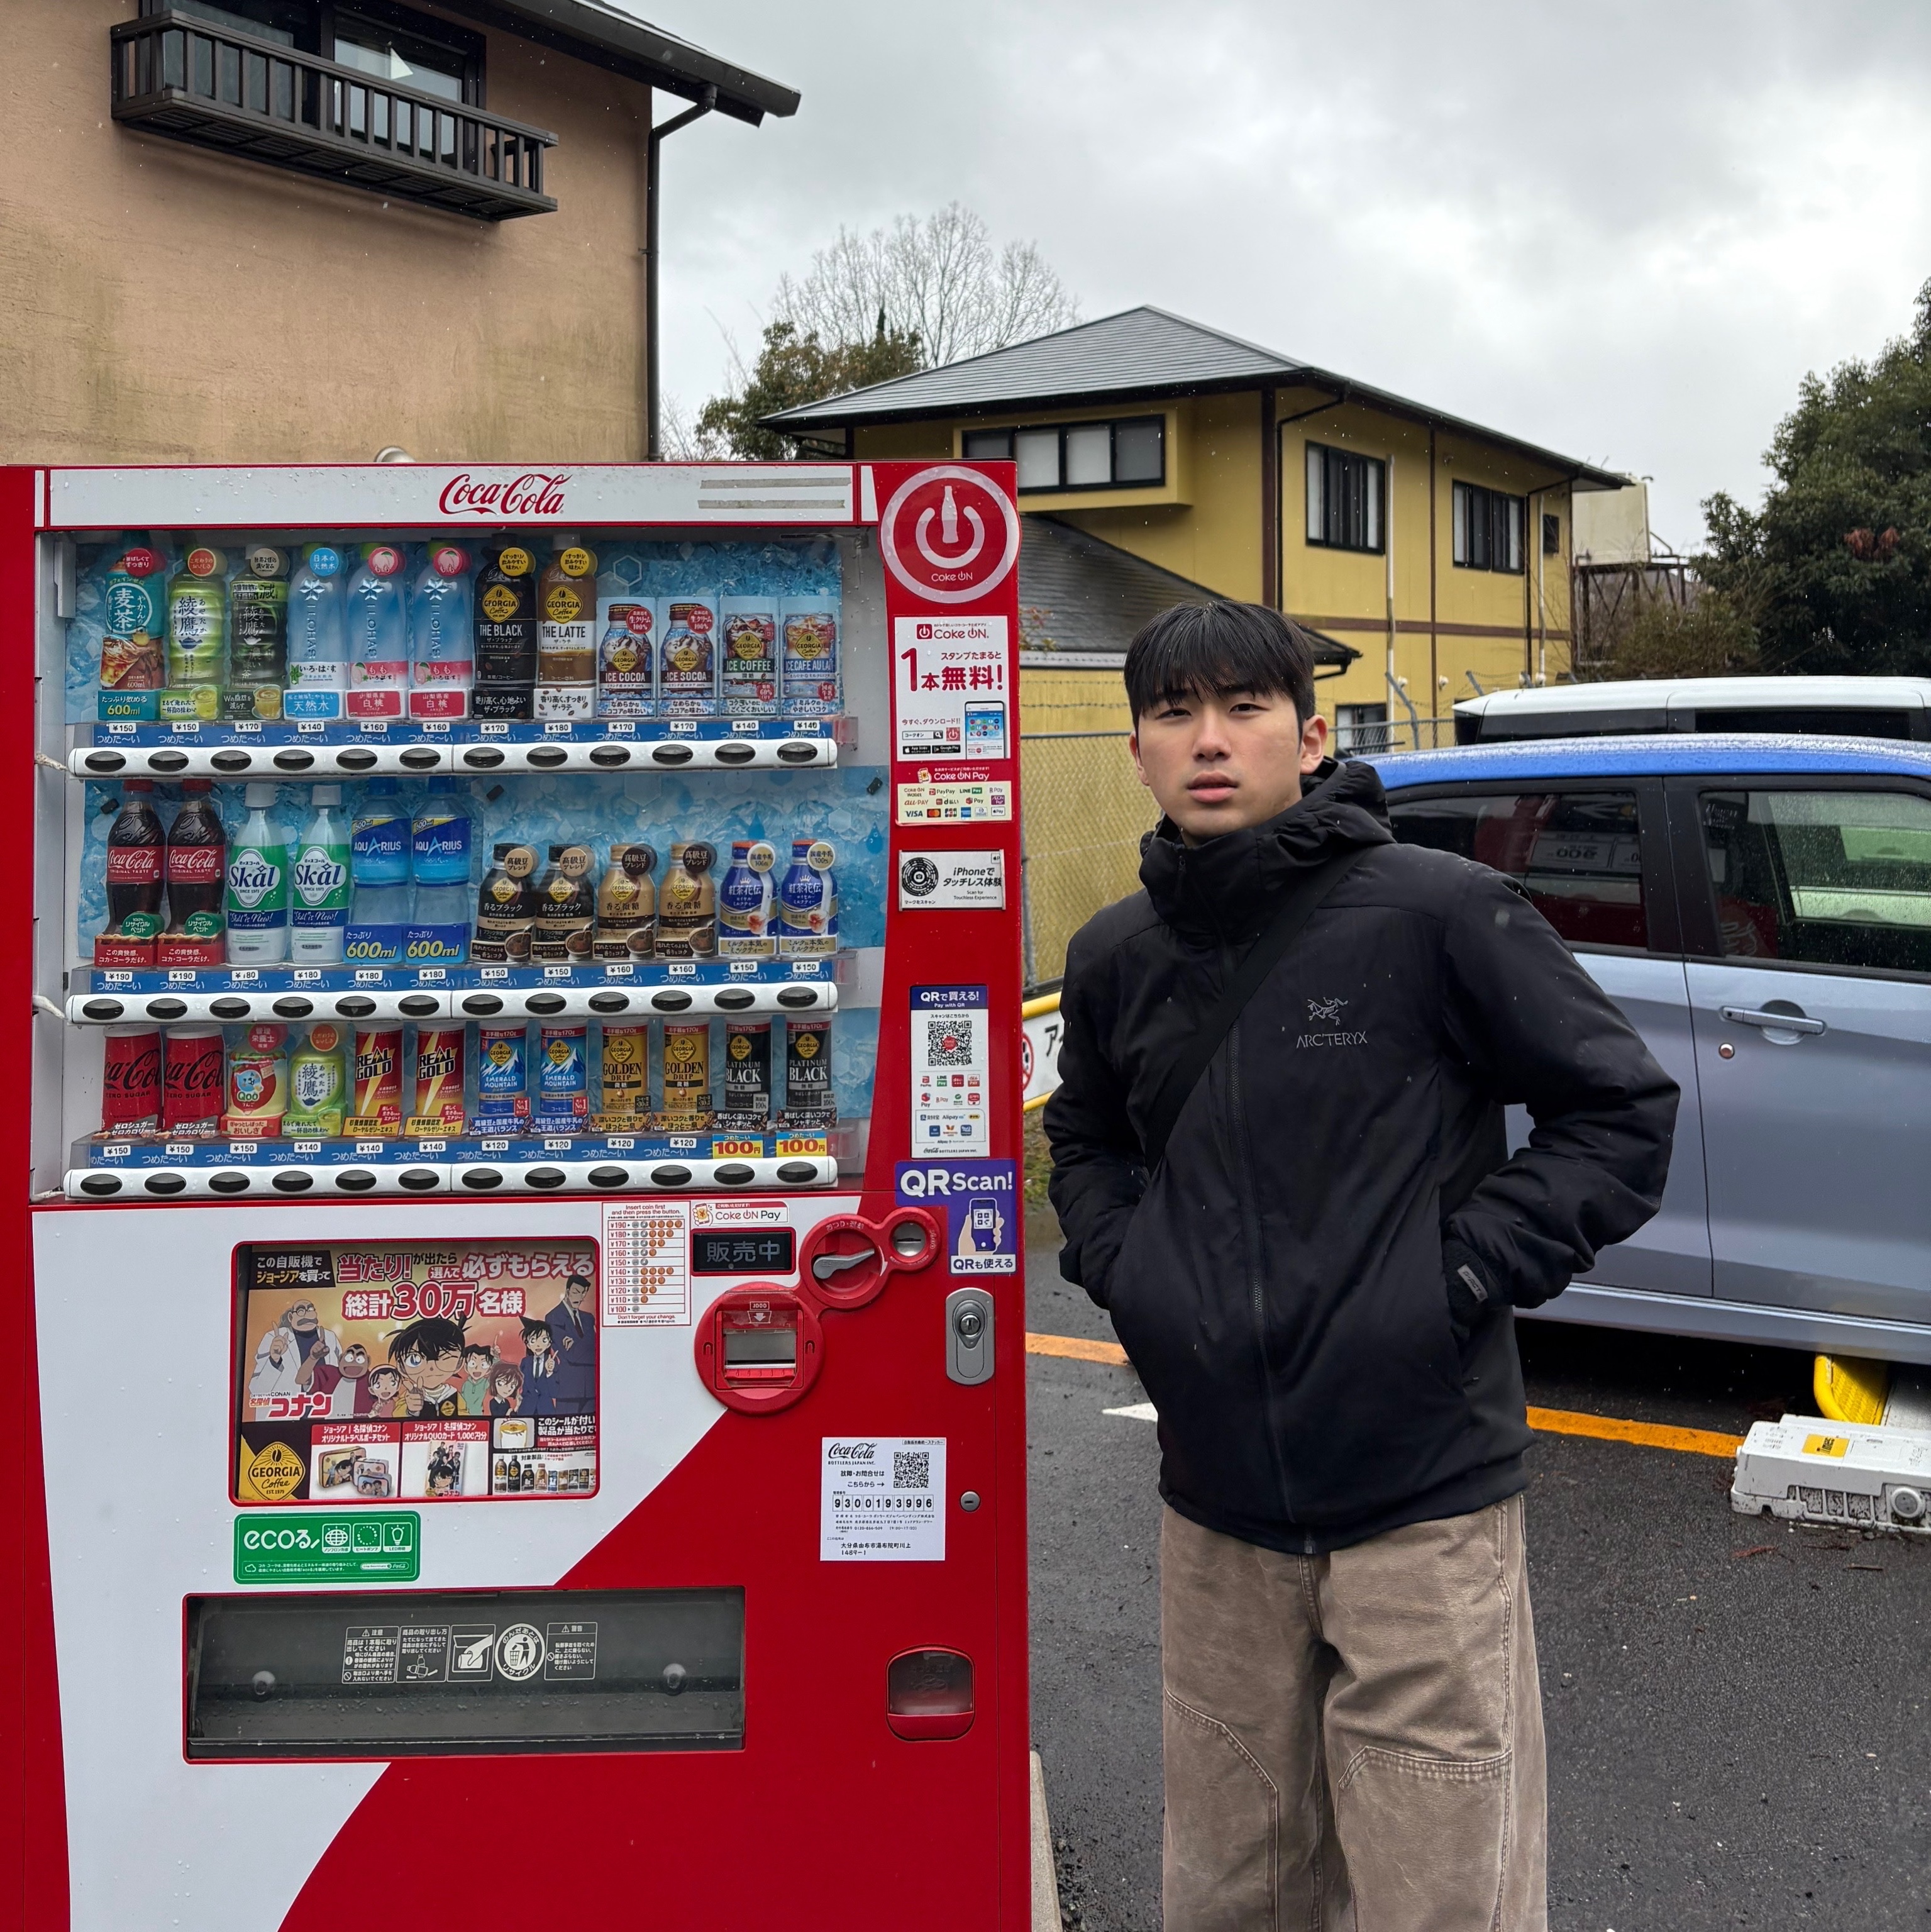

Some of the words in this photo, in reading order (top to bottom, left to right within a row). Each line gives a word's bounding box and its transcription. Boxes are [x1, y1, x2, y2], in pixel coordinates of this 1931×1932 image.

[439, 474, 573, 515] Coca-Cola
[113, 587, 136, 628] 麦茶
[179, 596, 199, 636] 綾鷹
[480, 624, 492, 636] THE
[494, 624, 523, 636] BLACK
[542, 626, 556, 638] THE
[558, 626, 585, 638] LATTE
[941, 652, 1002, 660] スタンプたまると
[726, 660, 738, 670] ICE
[739, 660, 771, 670] COFFEE
[900, 647, 1003, 692] 1本無料!
[605, 672, 617, 682] ICE
[619, 672, 646, 682] COCOA
[101, 695, 147, 703] たっぷり飲める
[426, 700, 448, 708] 白桃
[475, 696, 526, 704] 香り高く、心地よい
[540, 695, 587, 703] 香り高く、すっきり
[293, 700, 329, 711] 天然水
[902, 718, 961, 726] 今すぐ、ダウンロード!!
[934, 772, 956, 780] Coke
[958, 771, 971, 780] ON
[973, 772, 990, 782] Pay
[353, 836, 402, 857] AQUARIUS
[953, 867, 995, 876] iPhoneで
[943, 877, 1002, 887] タッチレス体験
[728, 885, 761, 895] 紅茶花伝
[788, 883, 822, 894] 紅茶花伝
[484, 902, 523, 912] 香るブラック
[606, 902, 639, 911] 香る微糖
[346, 931, 372, 939] たっぷり
[346, 941, 397, 958] 600ml
[407, 940, 460, 957] 600ml
[920, 991, 979, 1002] QRで買える!
[1296, 1031, 1368, 1049] ARC'TERYX
[357, 1046, 392, 1067] REAL
[789, 1058, 827, 1067] PLATINUM
[357, 1059, 392, 1080] GOLD
[419, 1058, 455, 1080] GOLD
[603, 1062, 642, 1075] GOLDEN
[665, 1061, 704, 1075] GOLDEN
[789, 1066, 827, 1081] BLACK
[237, 1091, 259, 1101] Qoo
[714, 1141, 761, 1155] 100円
[900, 1169, 952, 1198] QR
[952, 1171, 1013, 1191] Scan!
[715, 1210, 742, 1220] Coke
[743, 1209, 759, 1219] ON
[760, 1210, 781, 1221] Pay
[706, 1240, 781, 1263] 販売中
[257, 1255, 323, 1269] この自販機で
[413, 1253, 458, 1265] が出たら
[953, 1258, 1013, 1270] QRも使える
[430, 1267, 460, 1279] 選んで
[462, 1253, 594, 1279] 必ずもらえる
[257, 1269, 331, 1284] ジョージアを買って
[249, 1397, 270, 1407] 名探偵
[268, 1392, 332, 1418] コナン
[353, 1424, 387, 1433] 名探偵コナン
[321, 1435, 390, 1443] オリジナルトラベルポーチセット
[404, 1432, 456, 1441] オリジナルQUOカード
[456, 1431, 488, 1441] 1,000円分
[828, 1443, 878, 1459] Coca-Cola
[252, 1467, 302, 1478] GEORGIA
[261, 1478, 290, 1490] Coffee
[502, 1627, 540, 1644] のんだあとは
[502, 1663, 536, 1677] リサイクル
